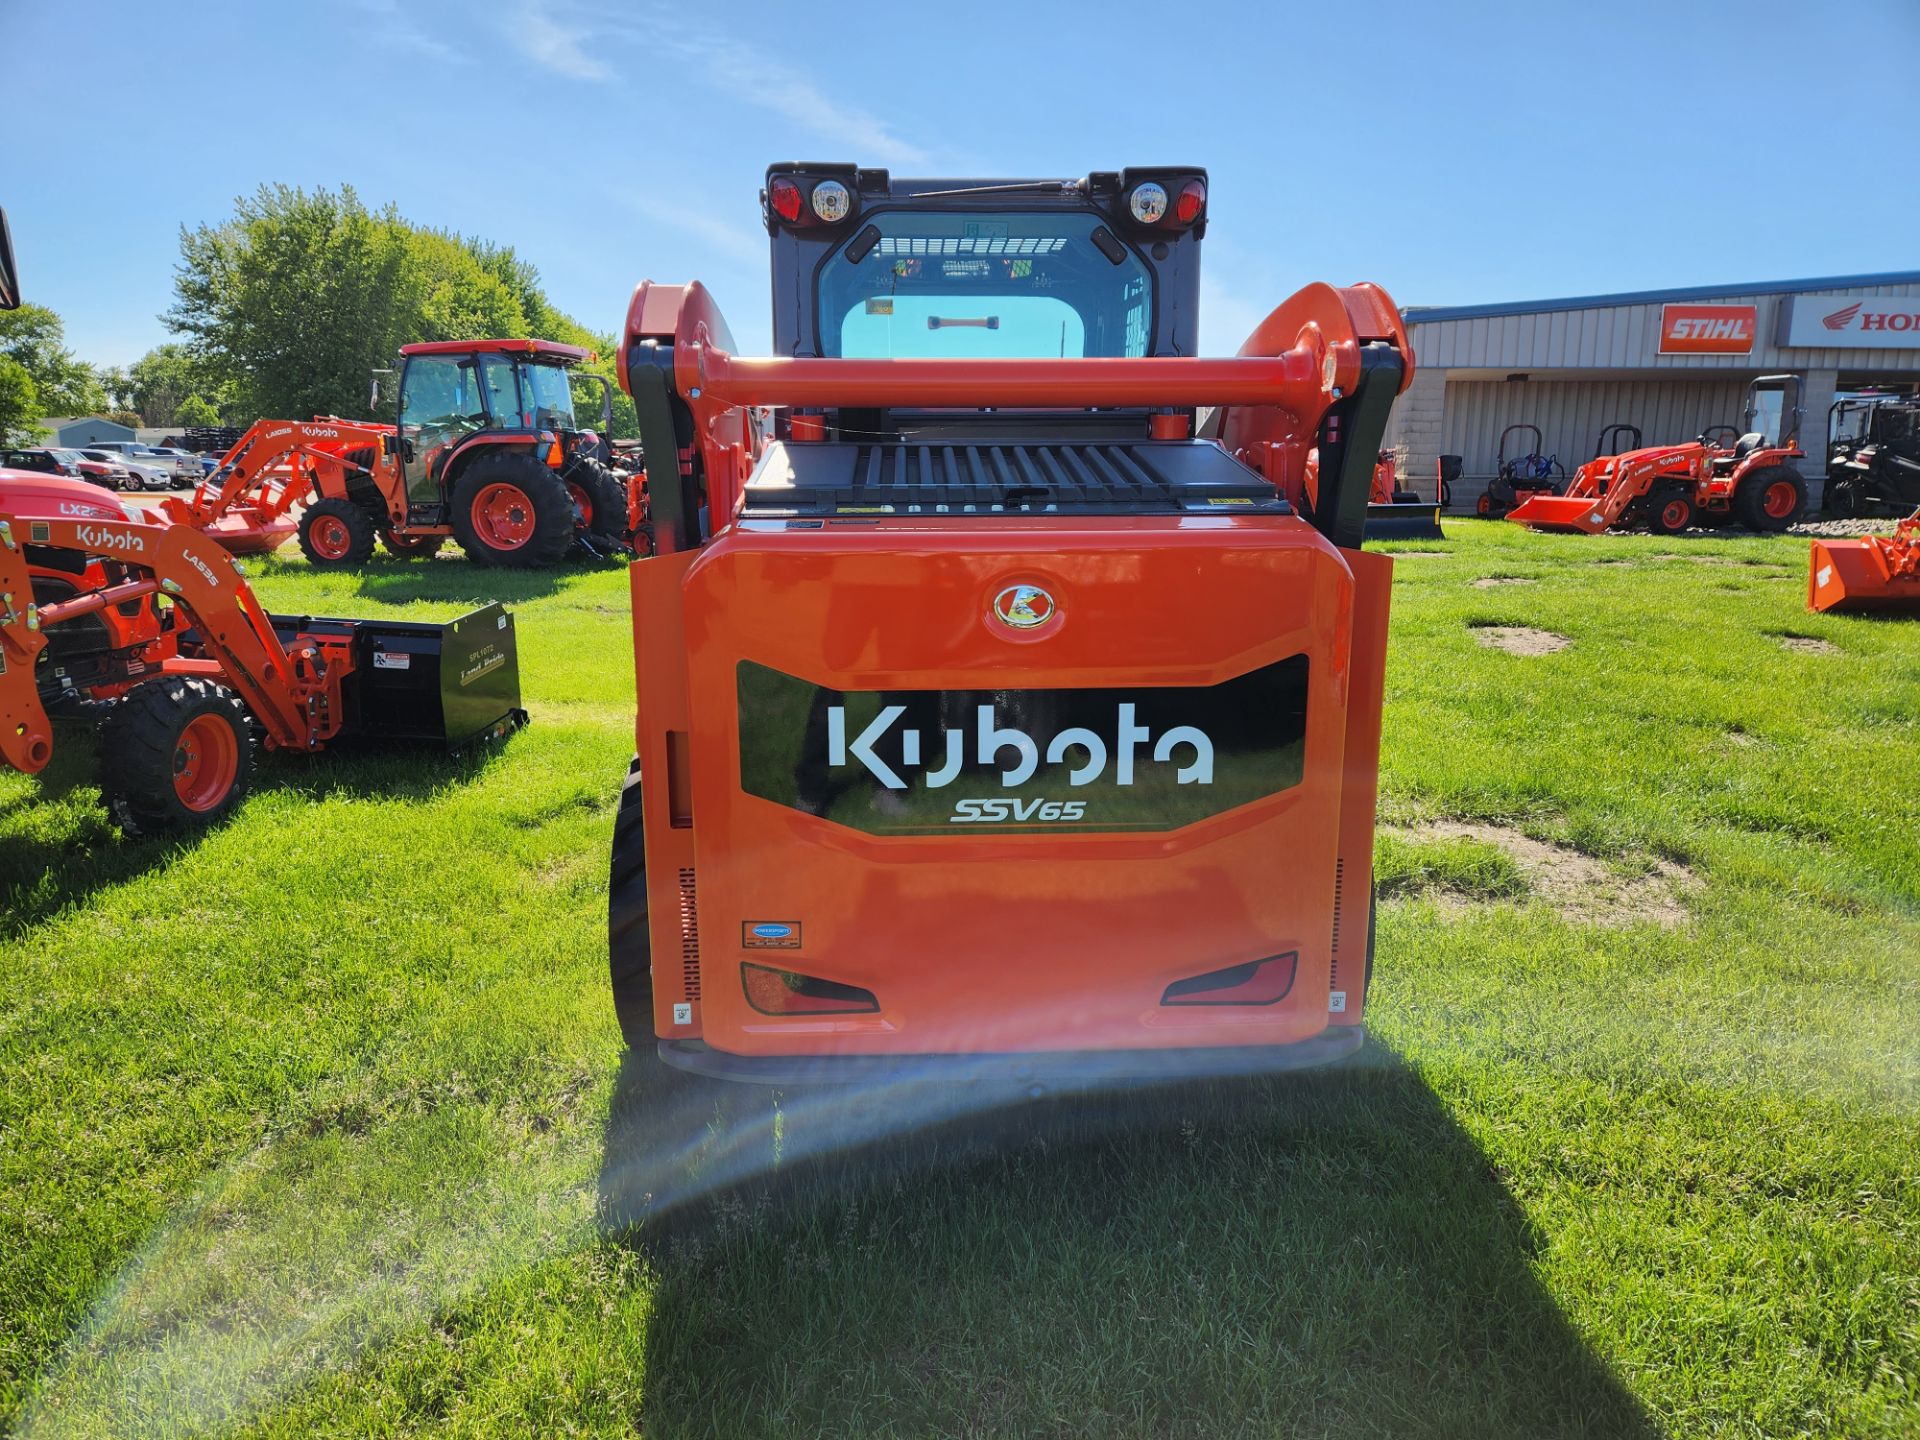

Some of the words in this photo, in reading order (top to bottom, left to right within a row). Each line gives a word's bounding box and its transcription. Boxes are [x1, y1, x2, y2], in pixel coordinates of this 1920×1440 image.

[1669, 319, 1749, 339] STIHL
[302, 426, 338, 438] Kubota
[1659, 455, 1685, 466] Kubota
[76, 524, 144, 551] Kubota
[182, 549, 219, 587] LA535
[827, 703, 1214, 789] Kubota
[950, 798, 1087, 822] SSV65
